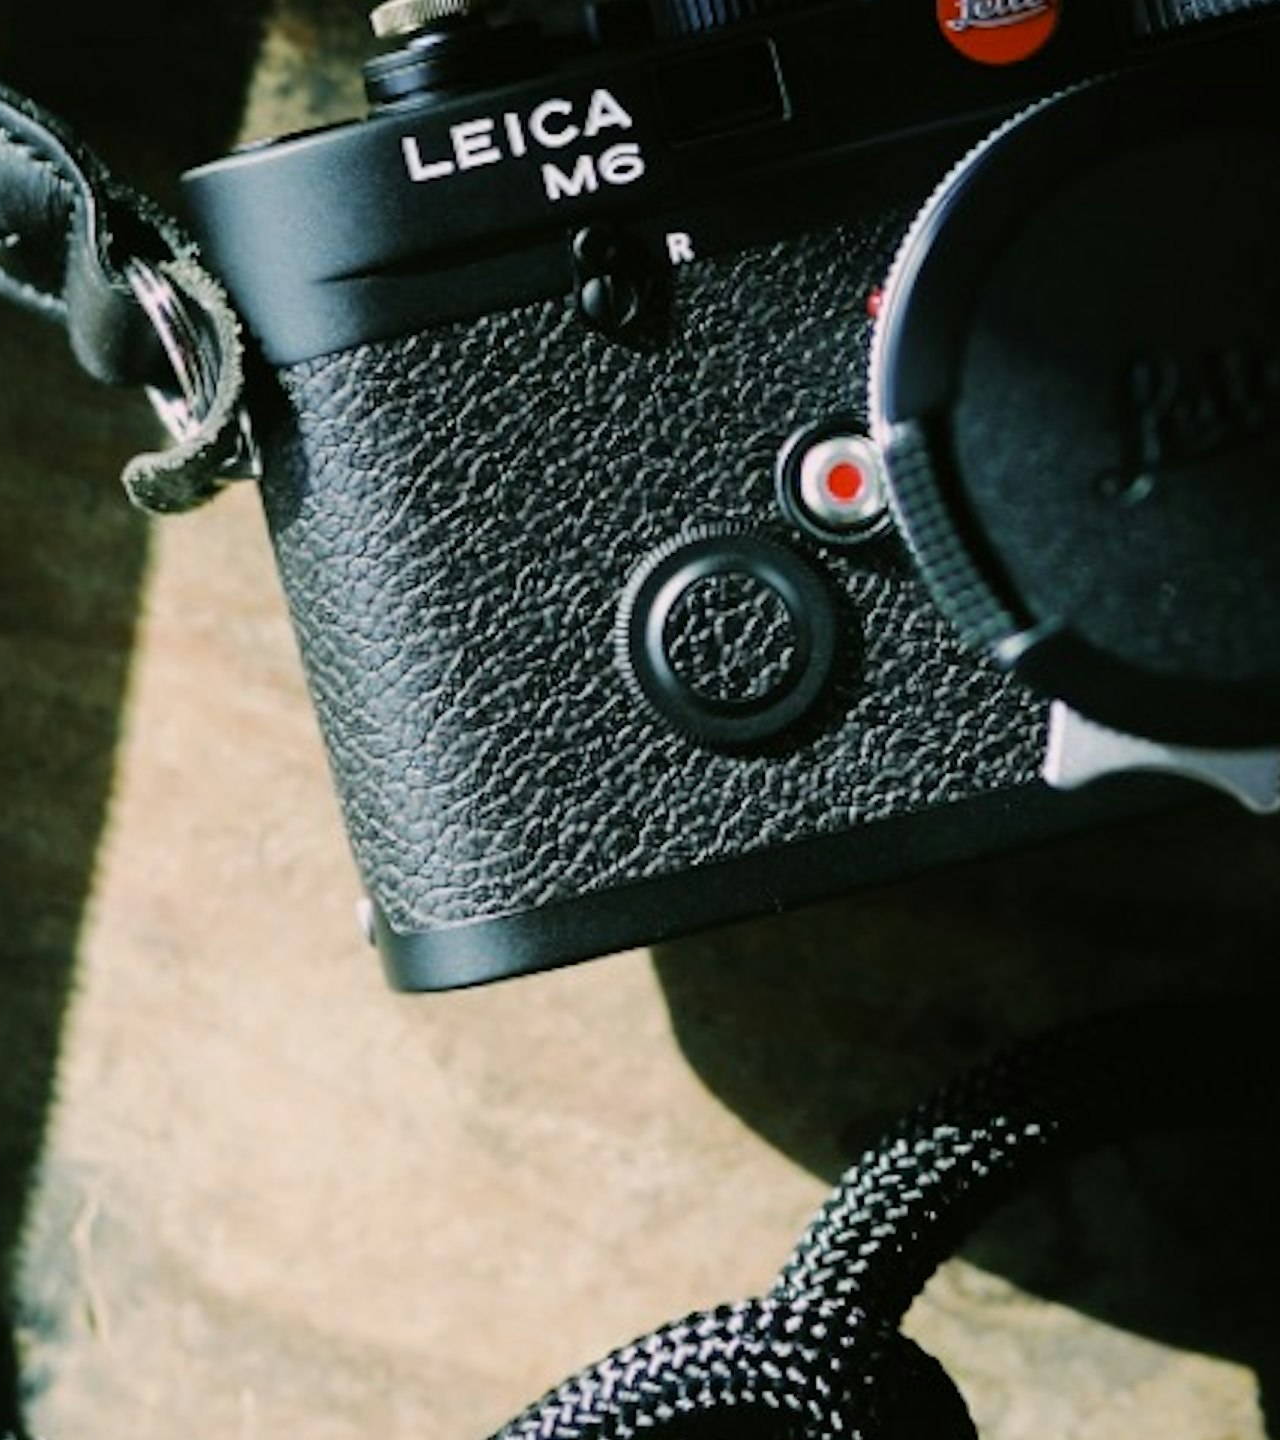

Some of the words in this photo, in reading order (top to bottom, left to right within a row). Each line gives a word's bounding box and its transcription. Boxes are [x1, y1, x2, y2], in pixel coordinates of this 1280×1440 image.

[401, 89, 632, 181] LEICA
[541, 143, 645, 200] M6
[666, 232, 694, 264] R
